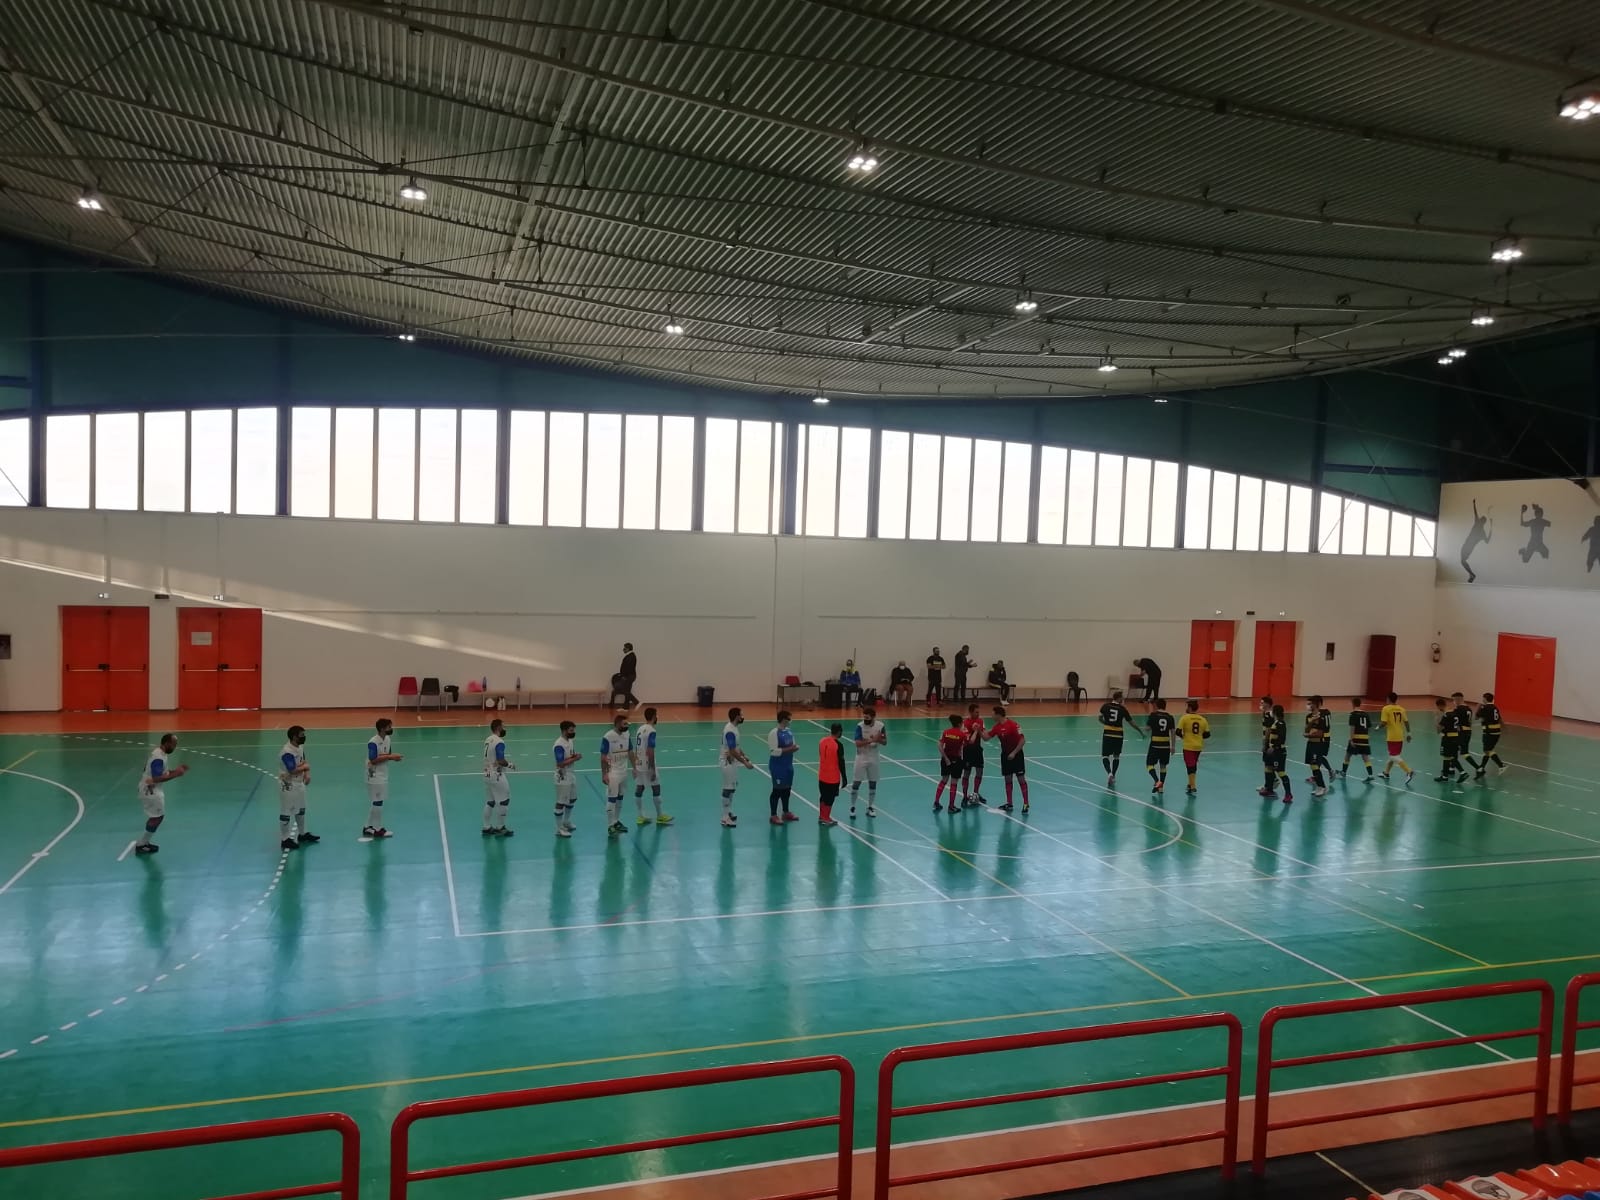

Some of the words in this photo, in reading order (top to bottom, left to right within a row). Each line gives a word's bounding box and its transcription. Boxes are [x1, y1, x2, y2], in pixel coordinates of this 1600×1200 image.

[1109, 709, 1118, 722] 3
[1393, 711, 1402, 723] 17
[1158, 718, 1167, 732] 9
[1192, 722, 1200, 734] 8
[1359, 716, 1367, 729] 4
[1453, 716, 1459, 729] 2
